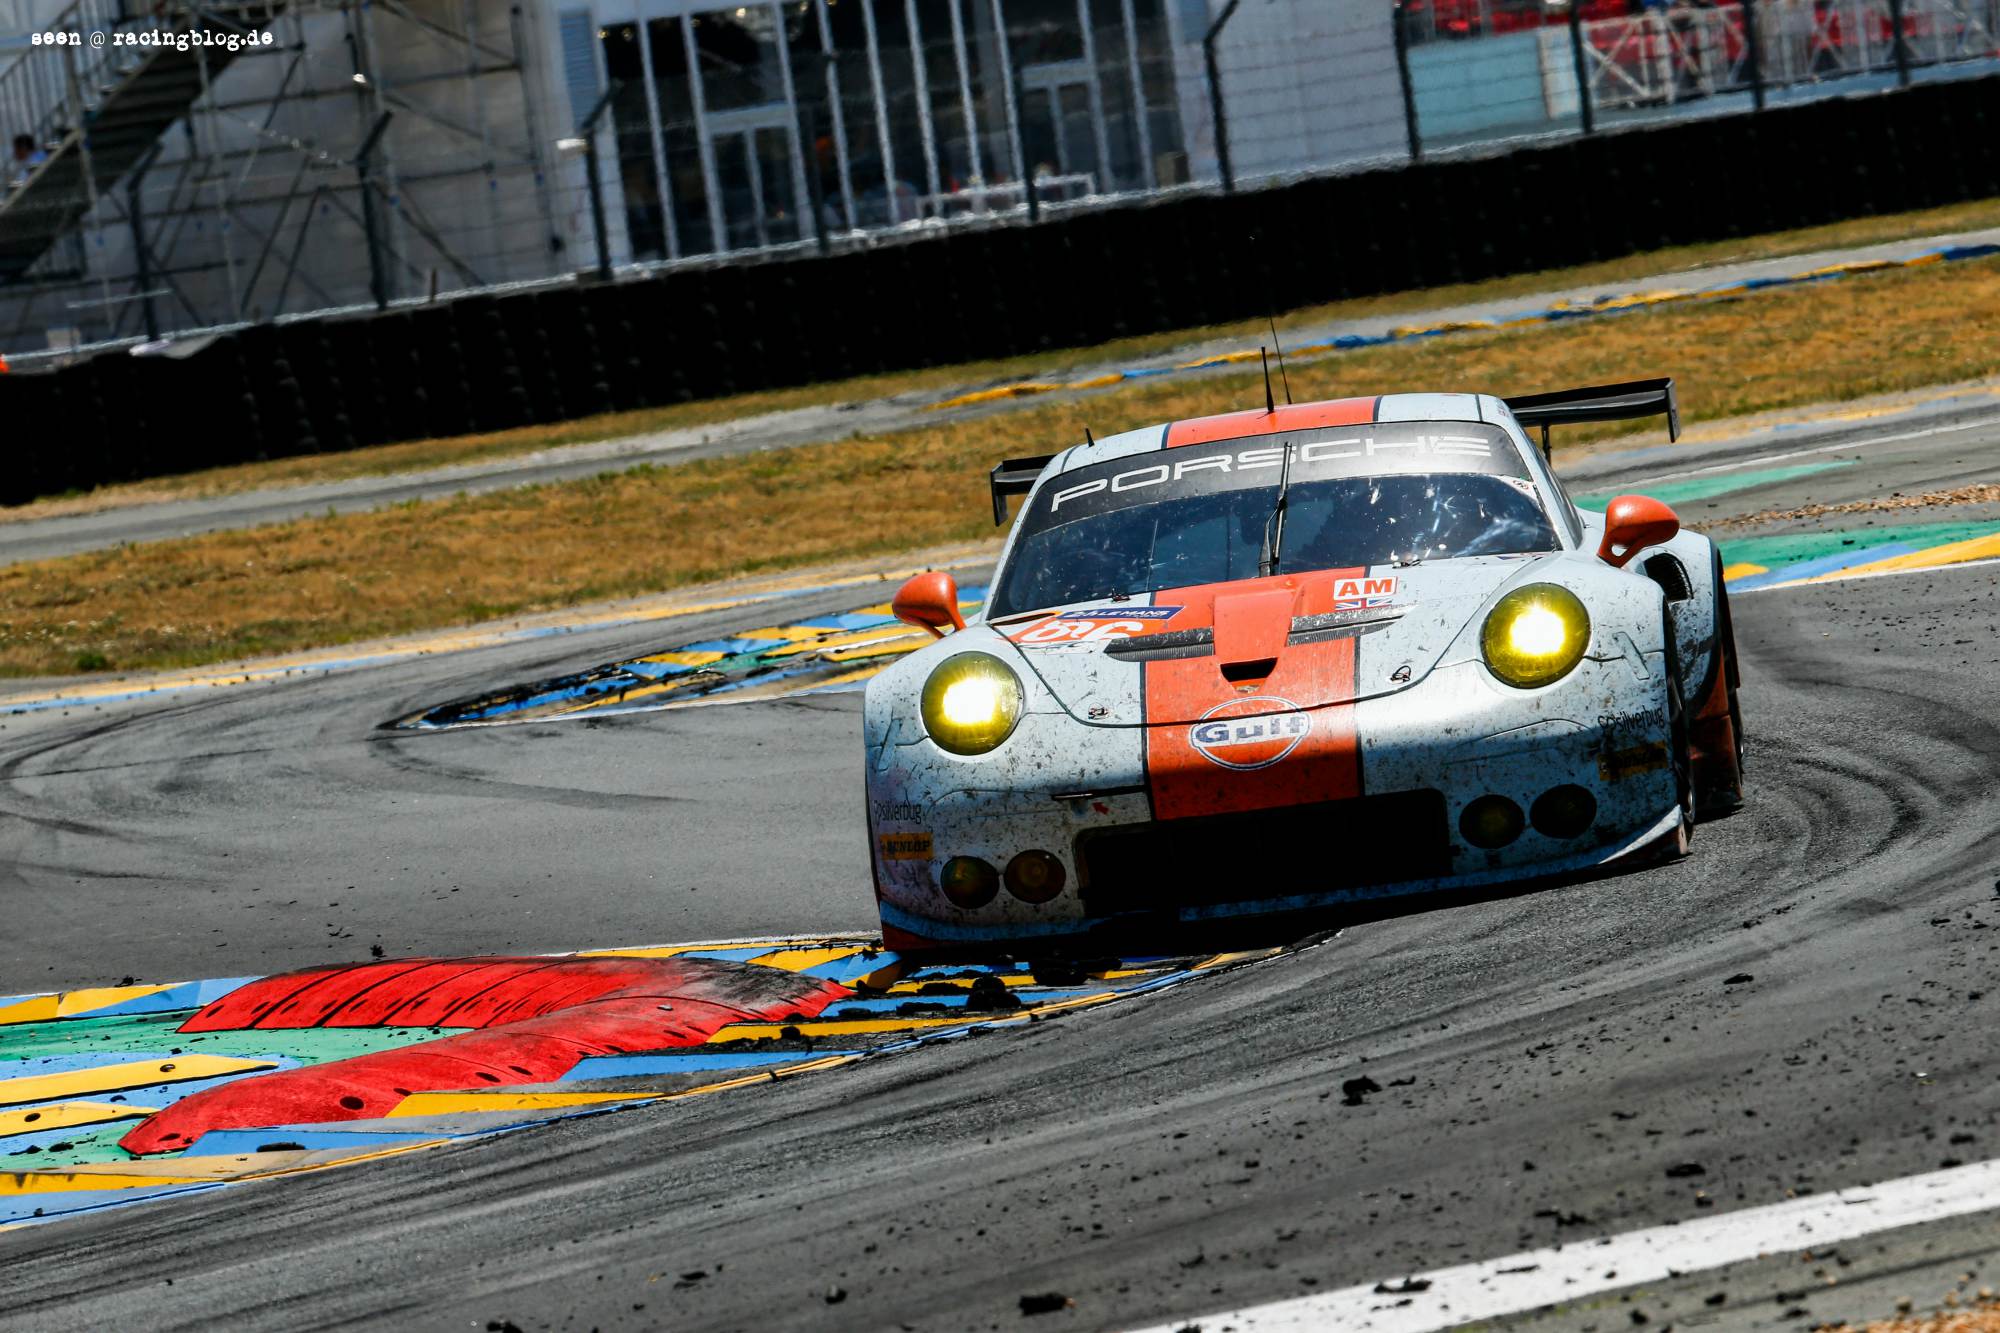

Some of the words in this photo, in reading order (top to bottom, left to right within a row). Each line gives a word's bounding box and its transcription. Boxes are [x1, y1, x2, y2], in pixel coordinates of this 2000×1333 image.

[1050, 435, 1492, 512] PORSCHE
[1337, 578, 1393, 597] AM
[1195, 715, 1306, 744] Gulf
